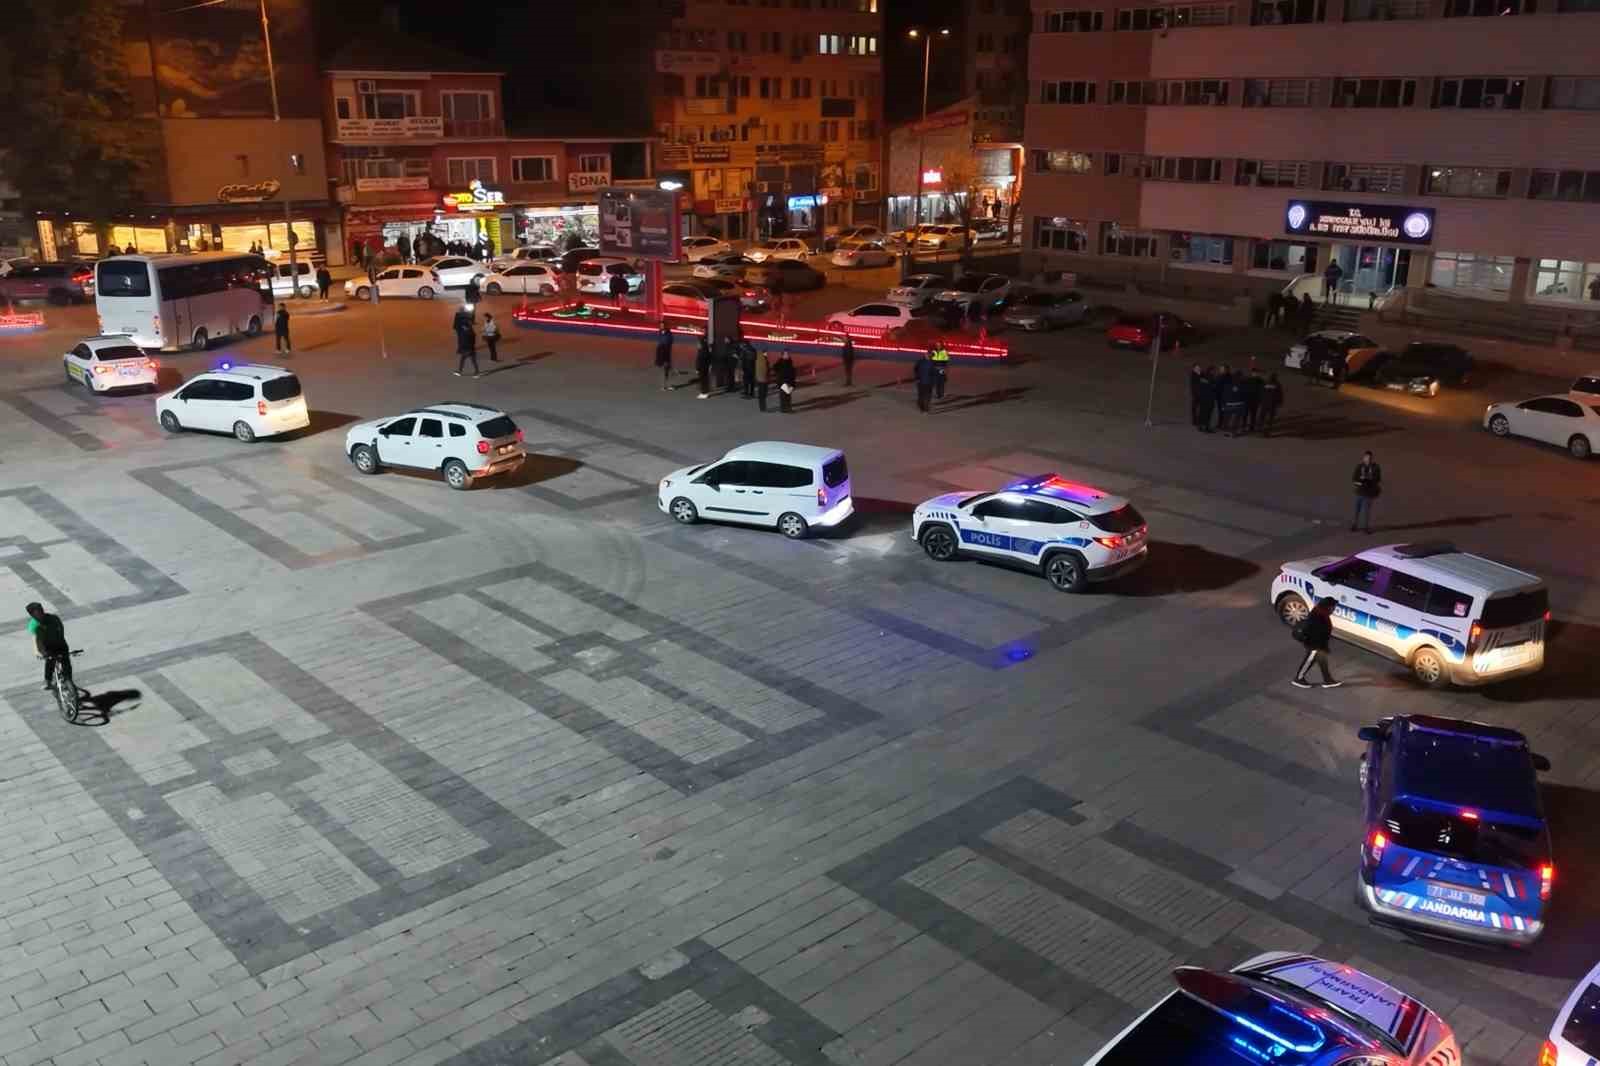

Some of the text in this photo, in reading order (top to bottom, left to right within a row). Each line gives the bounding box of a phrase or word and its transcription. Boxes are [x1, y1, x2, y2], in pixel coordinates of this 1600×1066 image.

[579, 175, 608, 186] DNA
[473, 188, 504, 203] SER
[1332, 606, 1357, 624] OLİS
[1419, 898, 1487, 922] JANDARMA
